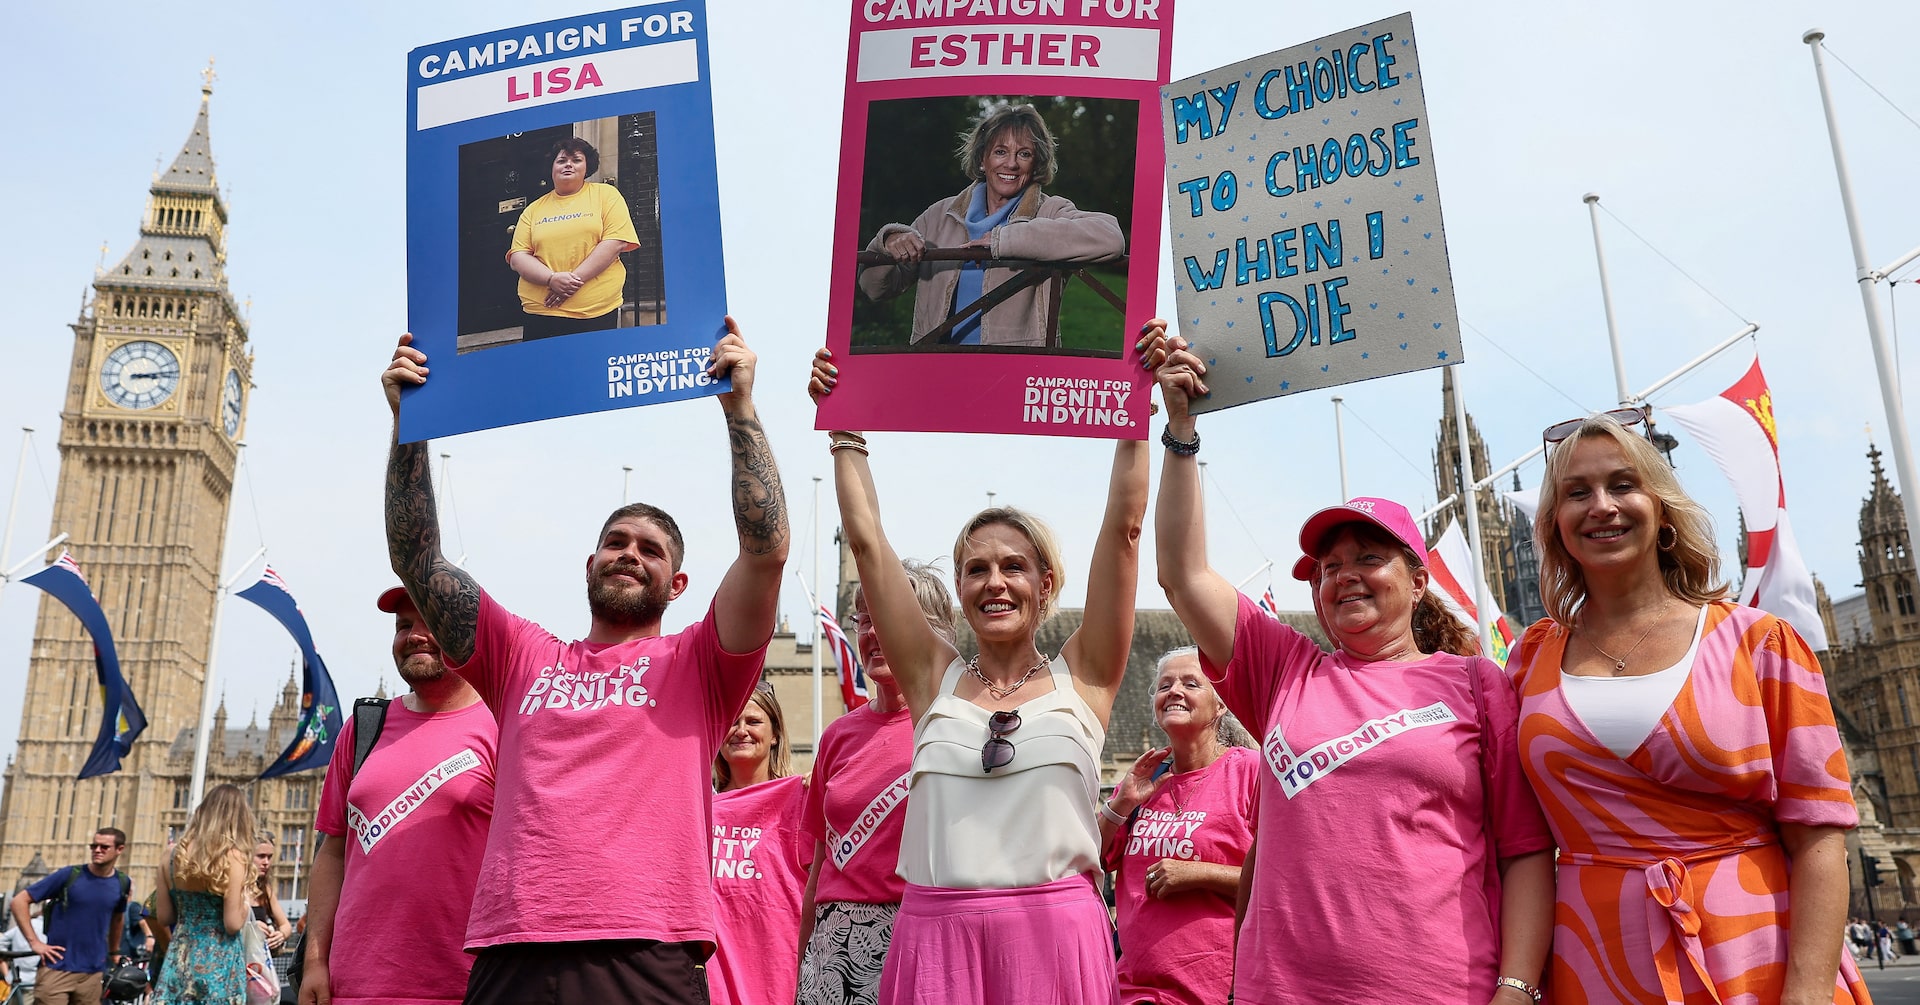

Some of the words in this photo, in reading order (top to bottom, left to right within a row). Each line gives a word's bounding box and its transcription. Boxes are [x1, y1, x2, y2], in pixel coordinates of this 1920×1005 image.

[863, 0, 1064, 23] CAMPAIGN
[1081, 0, 1160, 20] FOR
[418, 22, 607, 79] CAMPAIGN
[620, 10, 695, 42] FOR
[910, 33, 1102, 69] ESTHER
[507, 62, 604, 103] LISA
[1170, 80, 1240, 145] MY
[1253, 32, 1400, 120] CHOICE
[1178, 169, 1238, 218] TO
[1264, 118, 1420, 198] CHOOSE
[1183, 219, 1343, 292] WHEN
[1365, 210, 1384, 260] I
[1257, 276, 1357, 359] DIE
[607, 349, 679, 366] CAMPAIGN
[683, 347, 711, 358] FOR
[607, 356, 711, 383] DIGNITY
[608, 380, 633, 399] IN
[637, 371, 719, 395] DYING.
[1026, 376, 1099, 390] CAMPAIGN
[1103, 380, 1132, 392] FOR
[1024, 387, 1131, 409] DIGNITY
[1023, 405, 1048, 423] IN
[1052, 406, 1136, 428] DYING.
[619, 656, 651, 678] FR
[527, 666, 650, 702] DGNITY
[1266, 731, 1292, 774] YES
[348, 808, 368, 837] YES
[1132, 819, 1203, 839] GNITY
[1180, 811, 1207, 822] FOR
[731, 826, 762, 839] FOR
[712, 837, 760, 859] ITY
[712, 858, 763, 880] ING.
